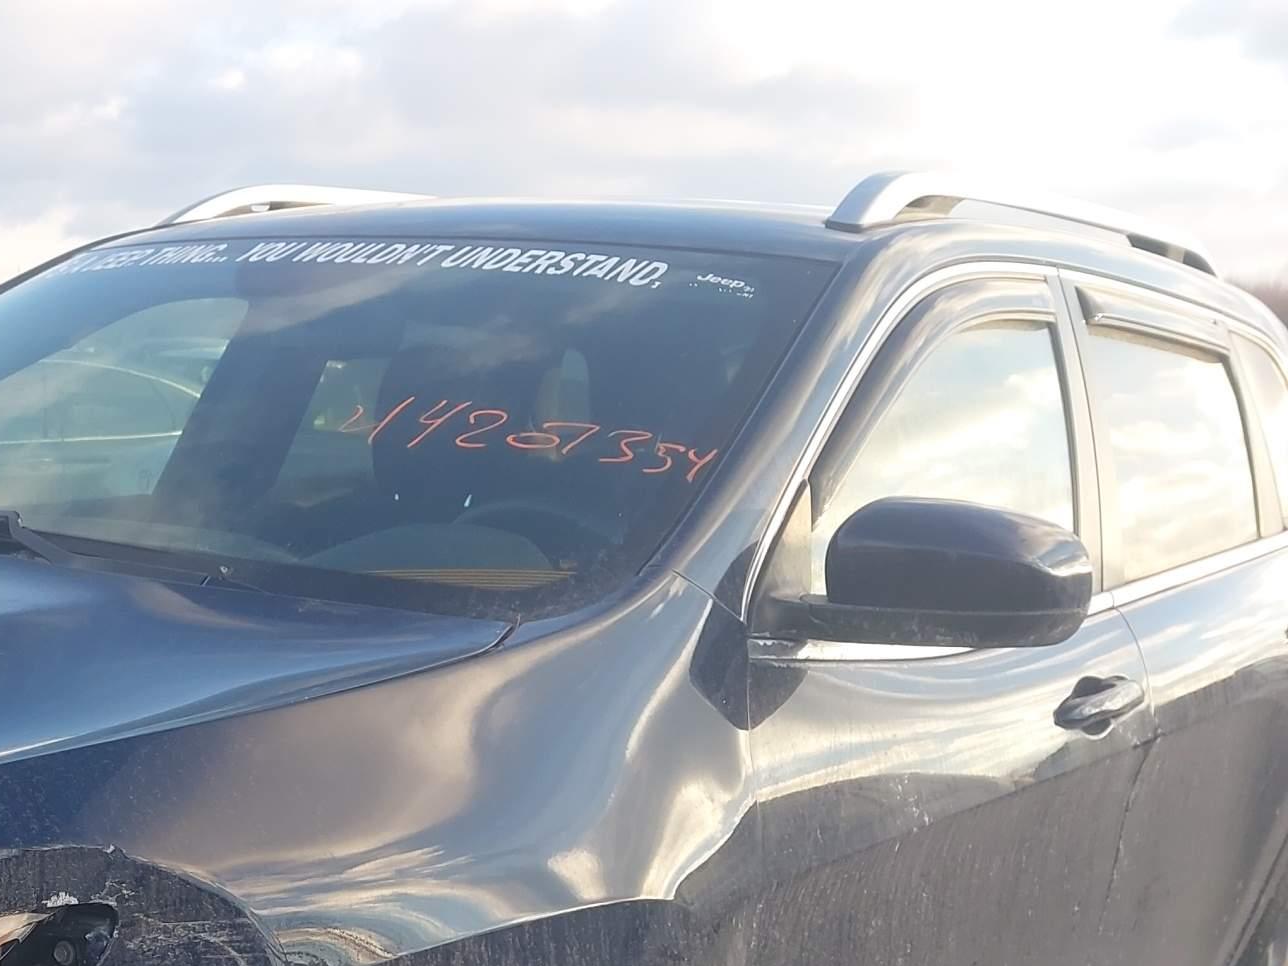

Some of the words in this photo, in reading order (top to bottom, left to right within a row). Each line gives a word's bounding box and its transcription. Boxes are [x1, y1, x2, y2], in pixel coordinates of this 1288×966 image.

[235, 242, 308, 263] YOU
[292, 242, 456, 266] WOULDN'T
[696, 273, 746, 289] Jeep
